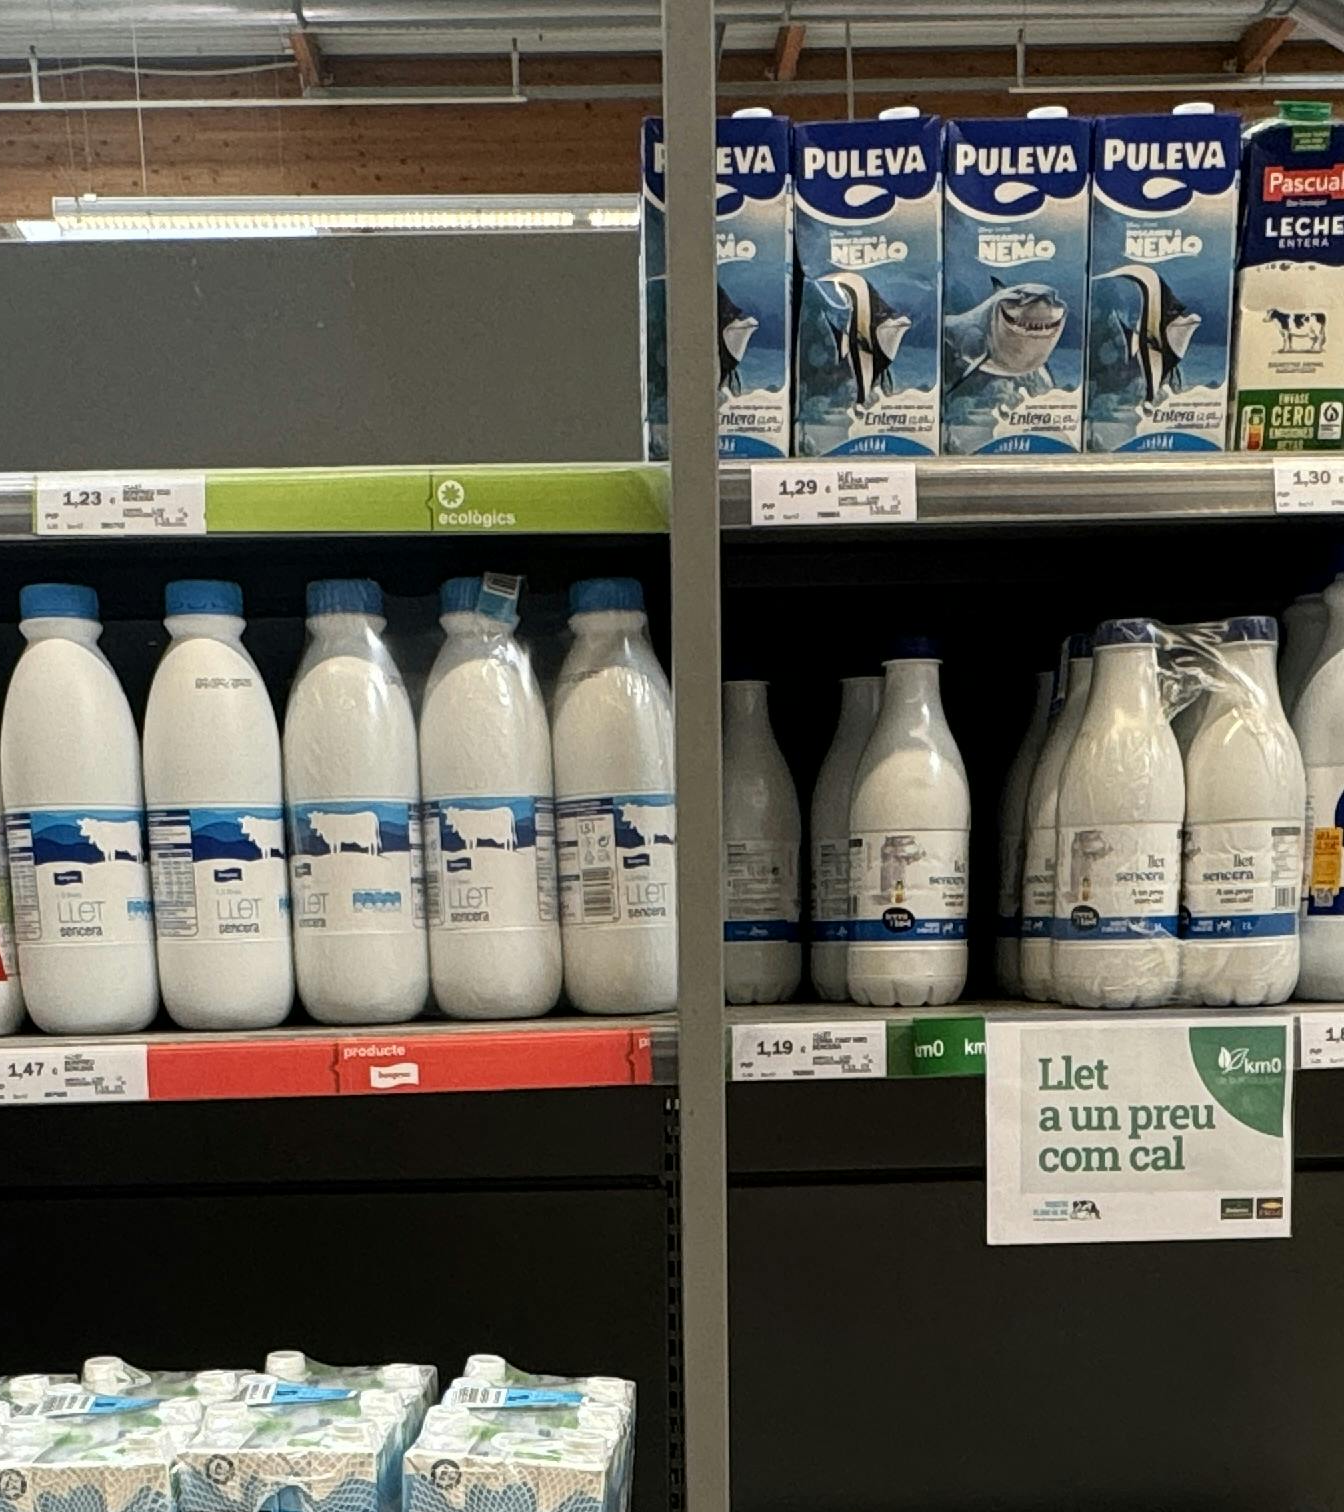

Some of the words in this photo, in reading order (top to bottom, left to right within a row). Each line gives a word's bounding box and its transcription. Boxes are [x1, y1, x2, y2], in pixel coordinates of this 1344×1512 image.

[804, 144, 927, 180] PULEVA
[955, 143, 1078, 176] PULEVA
[1104, 138, 1226, 172] PULEVA
[978, 237, 1056, 264] NEMO
[1124, 233, 1203, 263] NEMO
[778, 479, 818, 498] 1,29
[1291, 469, 1332, 487] 1,30
[62, 490, 103, 508] 1,23
[437, 508, 516, 529] ecològics
[343, 1043, 406, 1059] producte
[757, 1039, 794, 1057] 1,19
[8, 1062, 44, 1080] 1,47
[1038, 1055, 1109, 1091] Llet
[1244, 1056, 1282, 1075] km0
[1038, 1108, 1062, 1132] a
[1069, 1104, 1121, 1131] un
[1128, 1101, 1216, 1140] preu
[1038, 1144, 1122, 1173] com
[1129, 1136, 1186, 1172] cal
